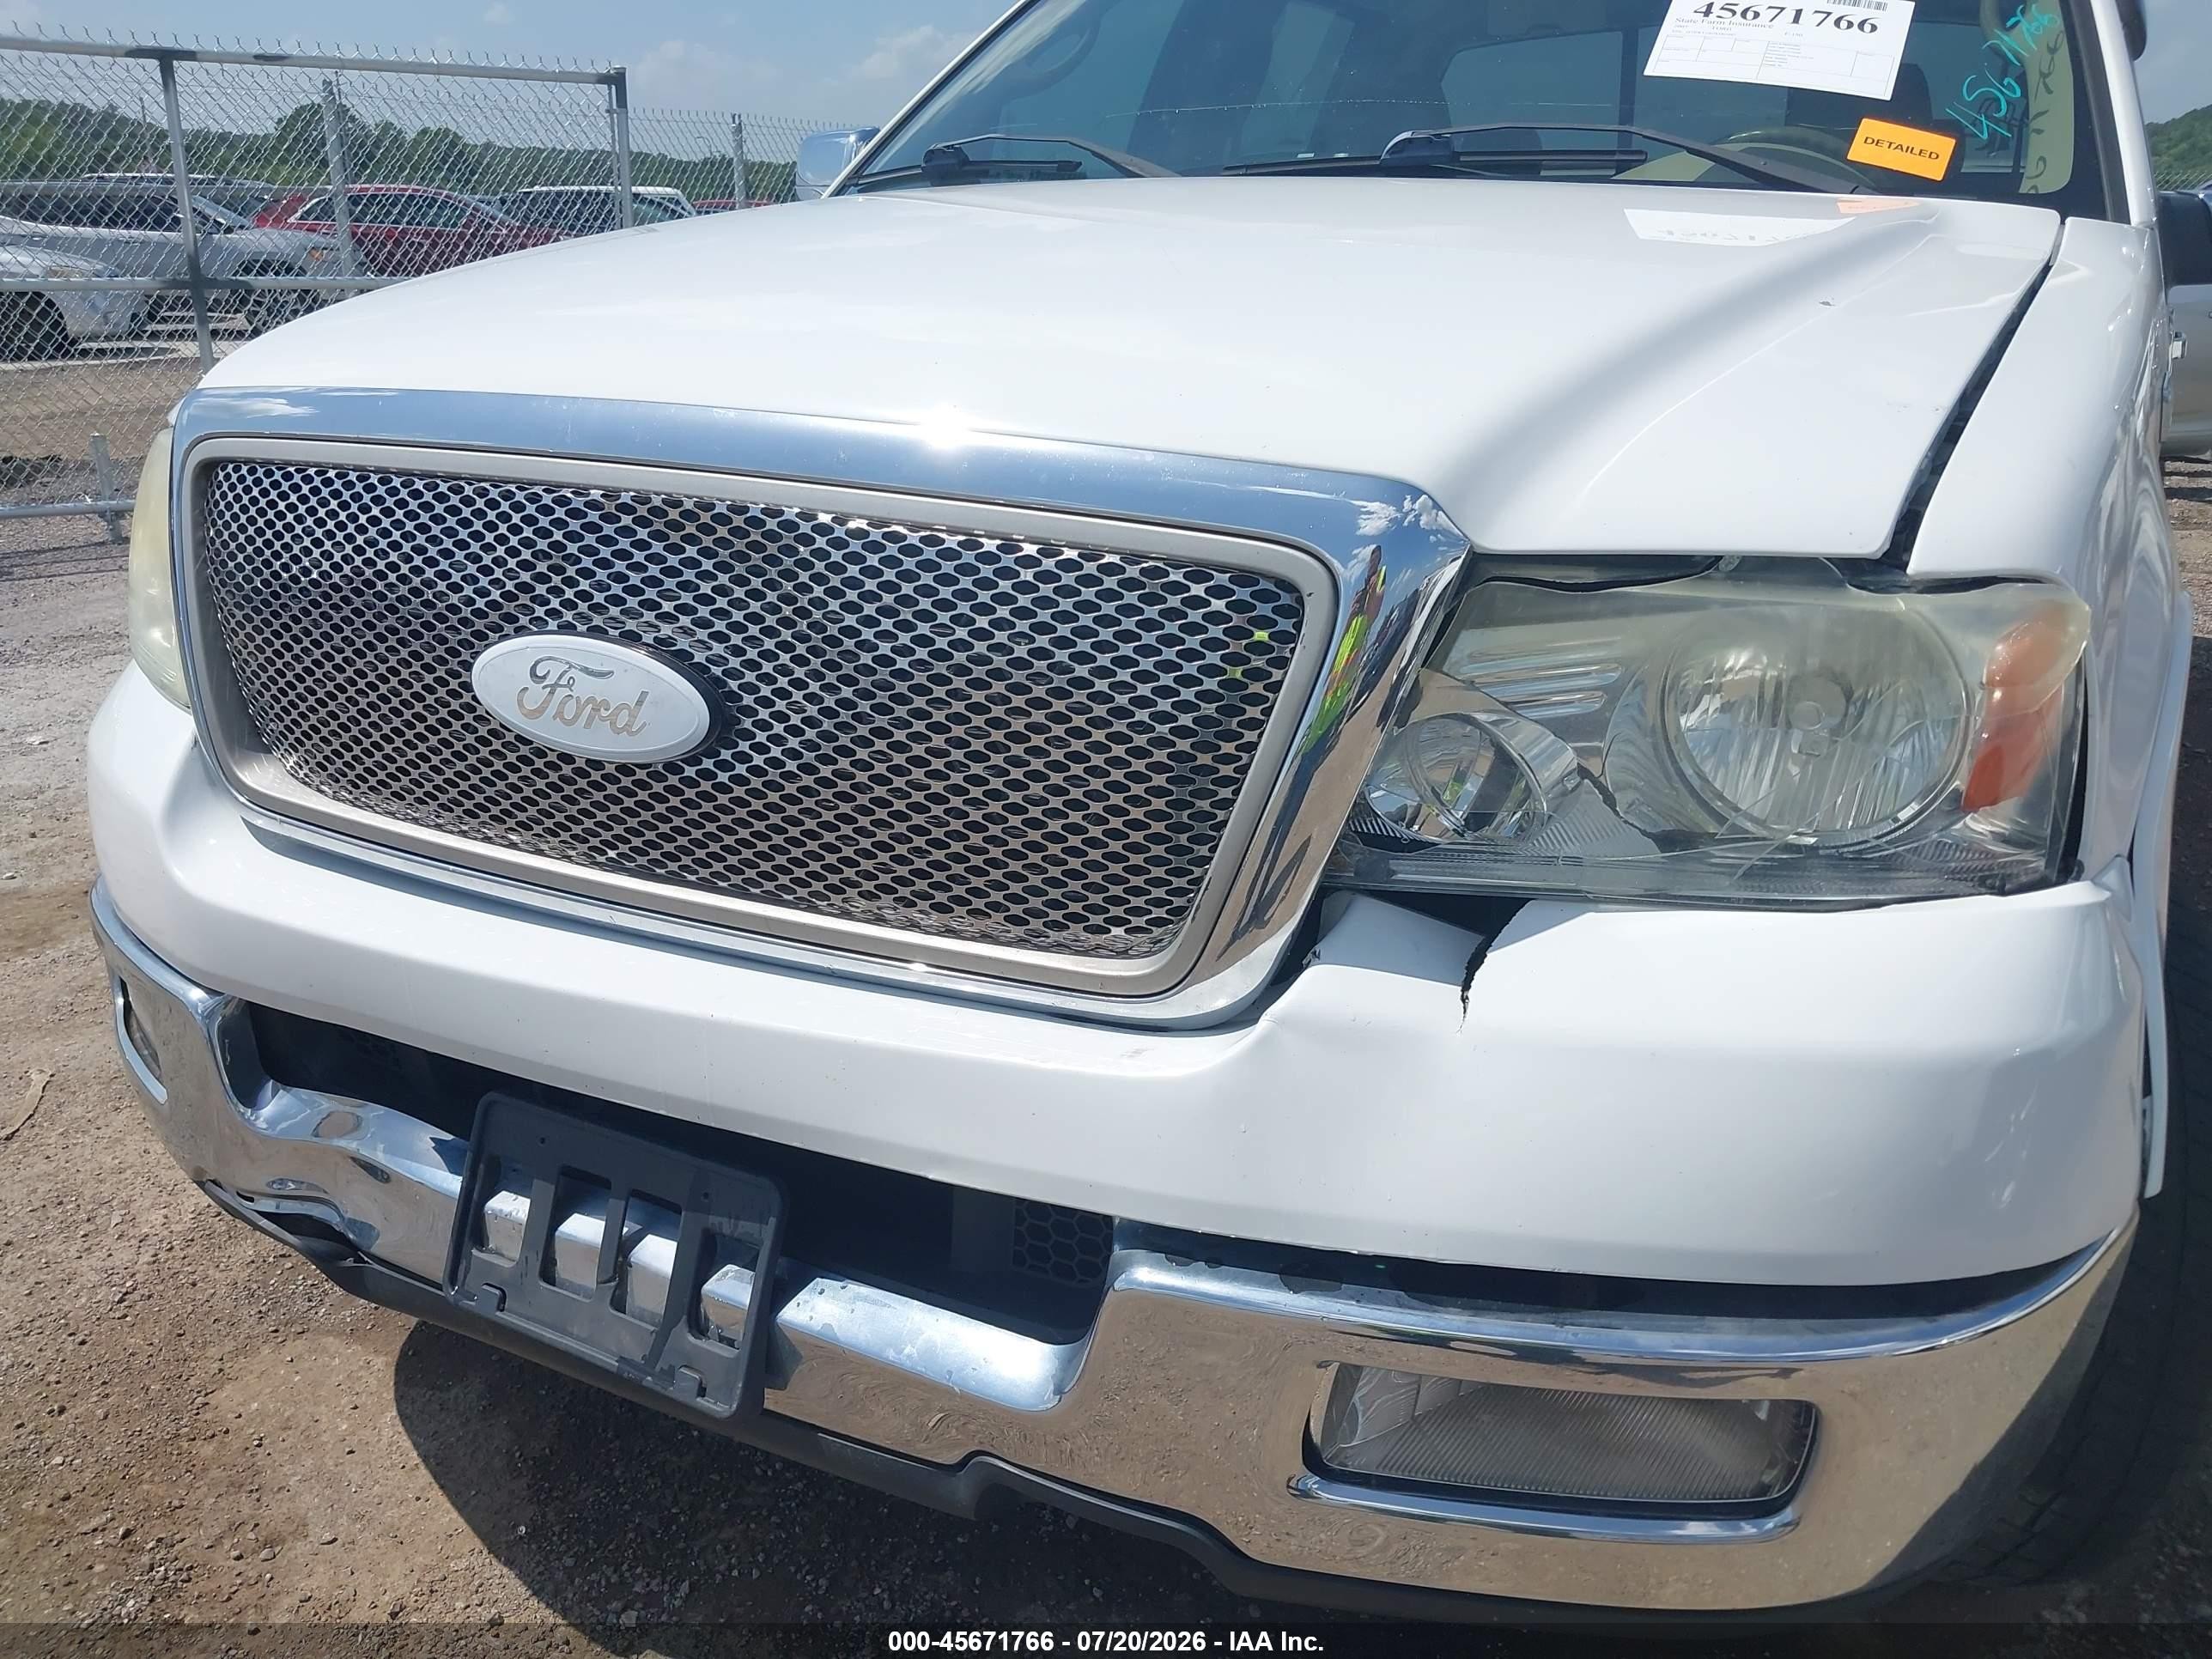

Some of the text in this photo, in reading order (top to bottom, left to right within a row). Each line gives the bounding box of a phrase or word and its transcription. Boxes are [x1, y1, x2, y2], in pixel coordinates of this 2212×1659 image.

[1693, 1, 1881, 33] 45671766
[1728, 20, 1775, 29] Insurance
[1863, 137, 1940, 160] DETAILED
[517, 656, 649, 736] Ford
